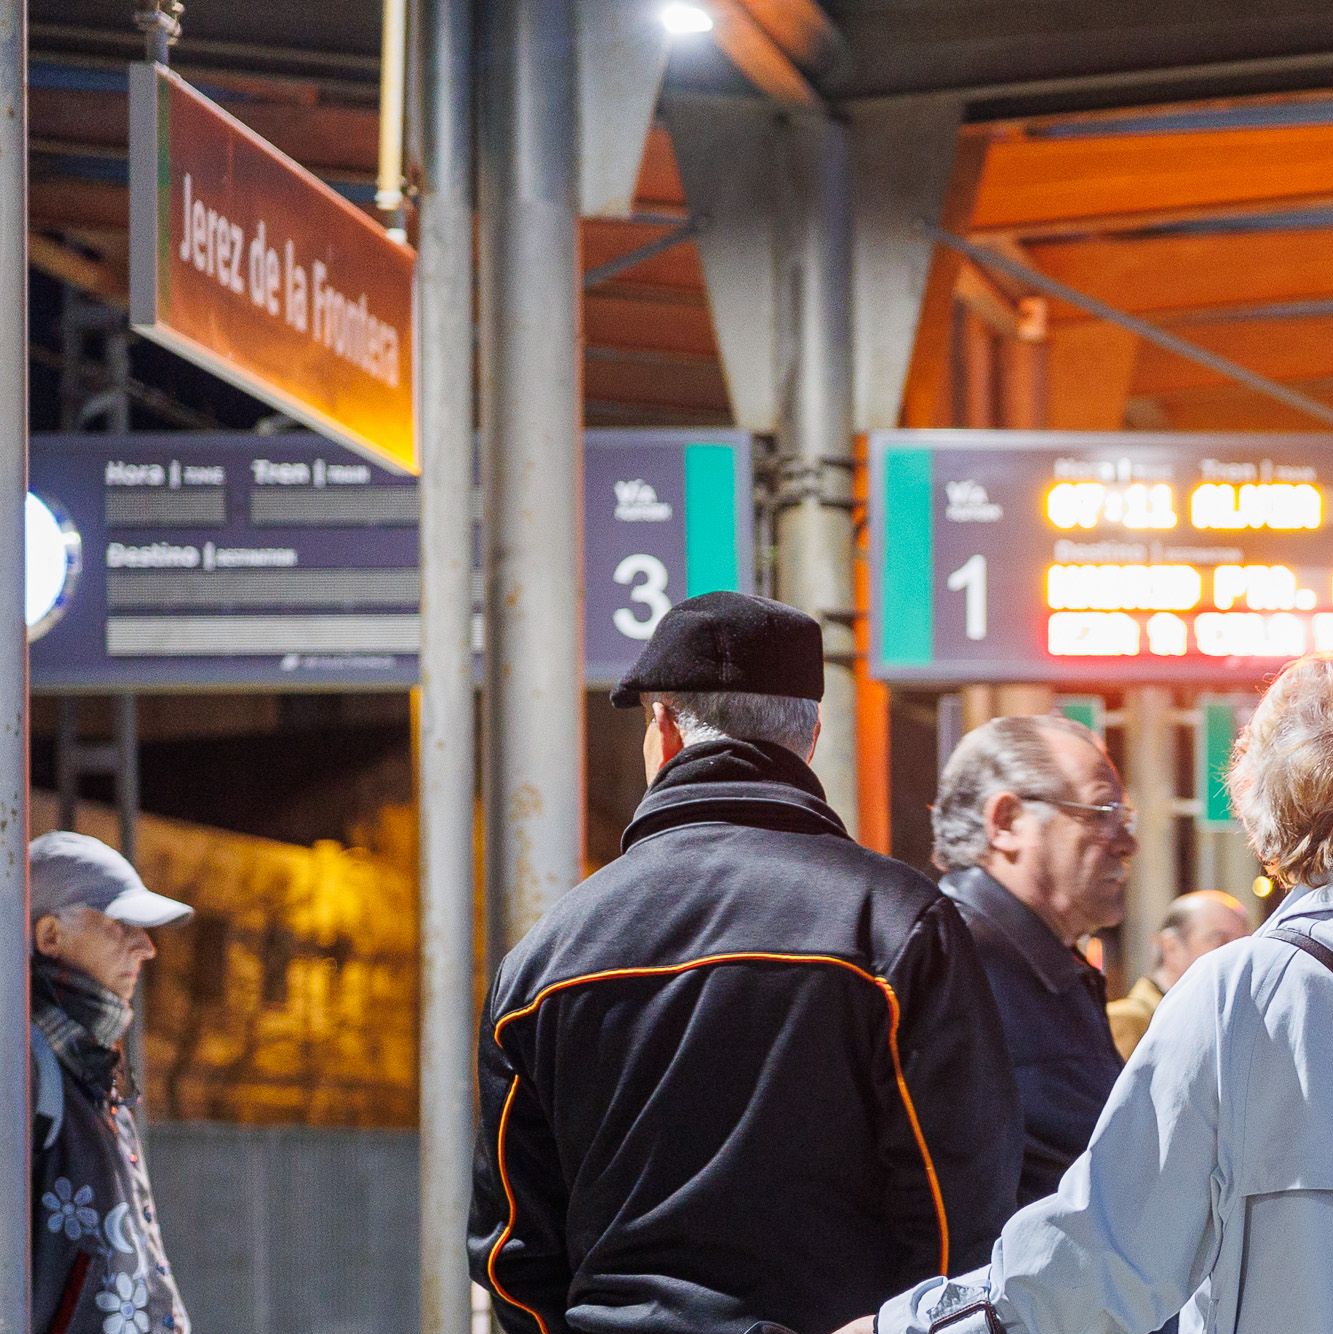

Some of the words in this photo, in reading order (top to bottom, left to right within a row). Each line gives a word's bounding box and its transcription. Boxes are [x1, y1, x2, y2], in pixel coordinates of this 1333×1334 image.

[179, 172, 245, 295] Jerez
[248, 219, 280, 316] de
[284, 238, 309, 333] la
[312, 258, 400, 387] Frontera
[105, 460, 165, 486] Hora
[250, 458, 310, 485] Tren
[106, 542, 200, 568] Destino
[612, 553, 673, 640] 3
[947, 554, 987, 641] 1
